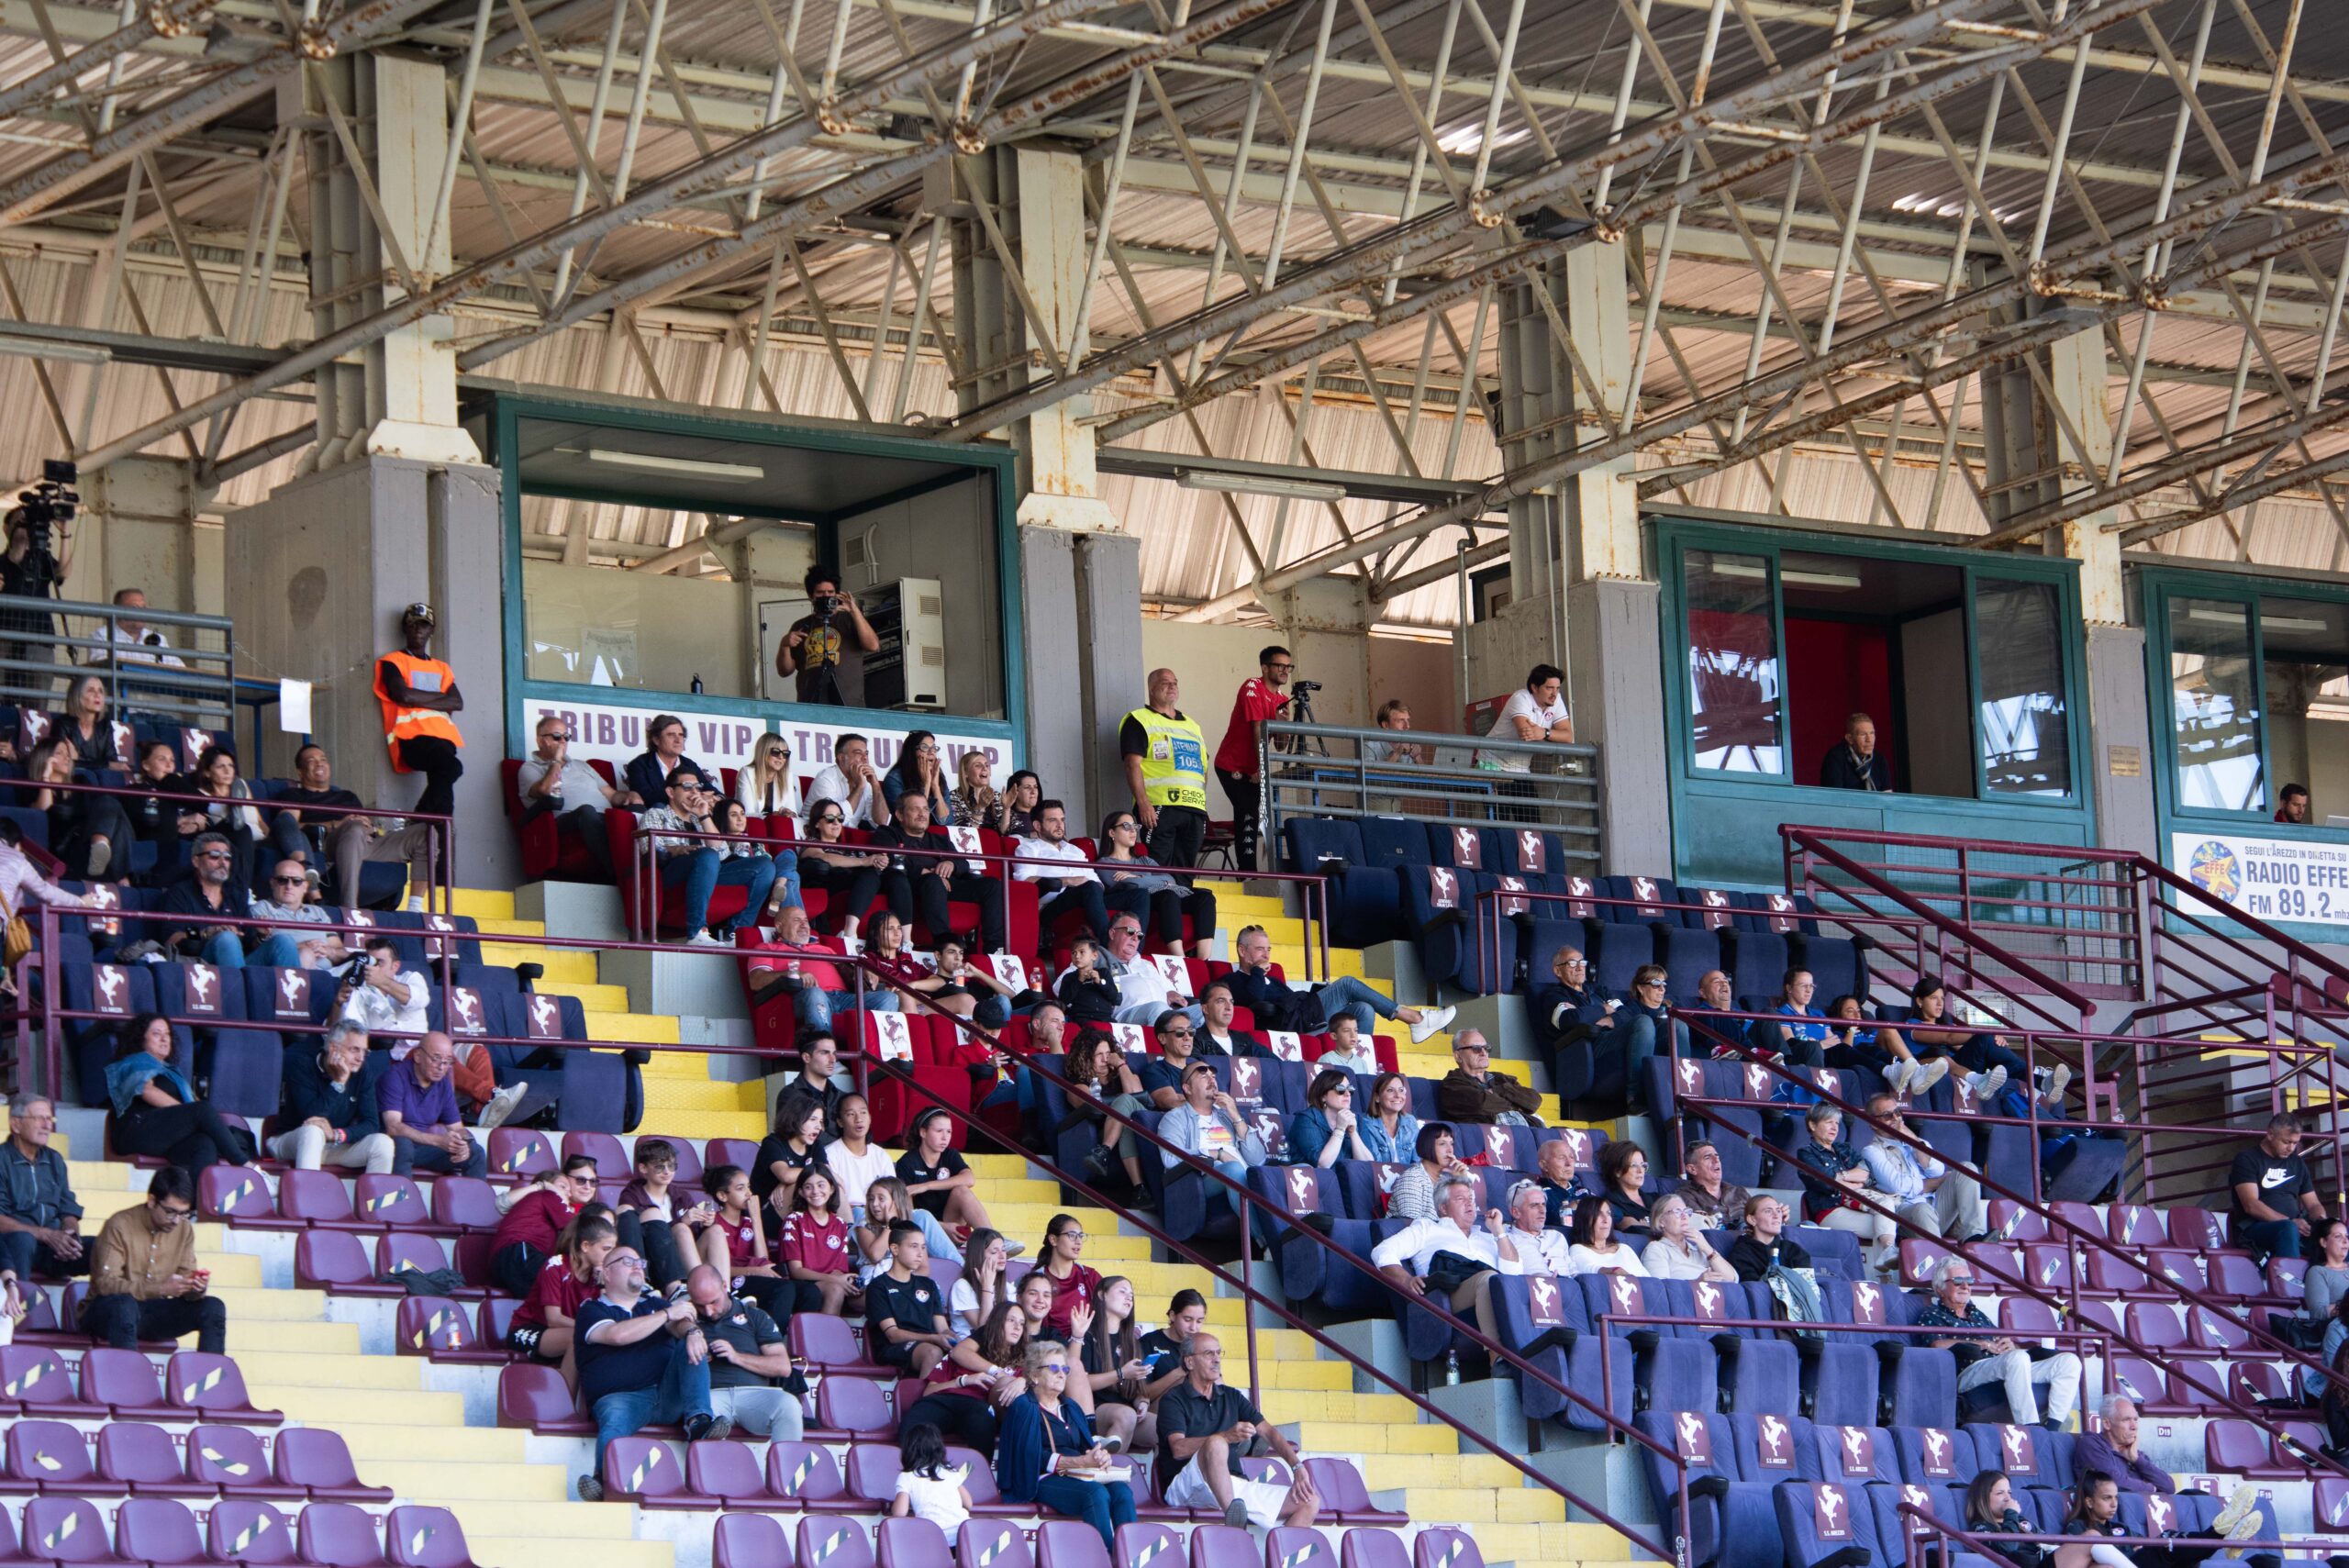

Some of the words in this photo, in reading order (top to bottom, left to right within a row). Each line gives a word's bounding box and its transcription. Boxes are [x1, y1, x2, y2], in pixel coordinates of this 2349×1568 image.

[539, 708, 685, 751] RIBU
[698, 721, 752, 756] VIP
[947, 743, 999, 775] VP
[1178, 755, 1198, 768] 105
[1181, 789, 1204, 799] CHECK
[2244, 846, 2265, 856] SEGUI
[2266, 848, 2297, 858] L'AREZZO
[2299, 850, 2306, 860] IN
[2337, 852, 2347, 862] SU
[2204, 862, 2225, 874] EFFE
[2246, 861, 2300, 885] RADIO
[2307, 864, 2349, 888] EFFE
[2248, 894, 2272, 914] FM
[2278, 888, 2331, 918] 89.2
[2266, 1167, 2288, 1179] NIKE
[2158, 1427, 2171, 1437] D19
